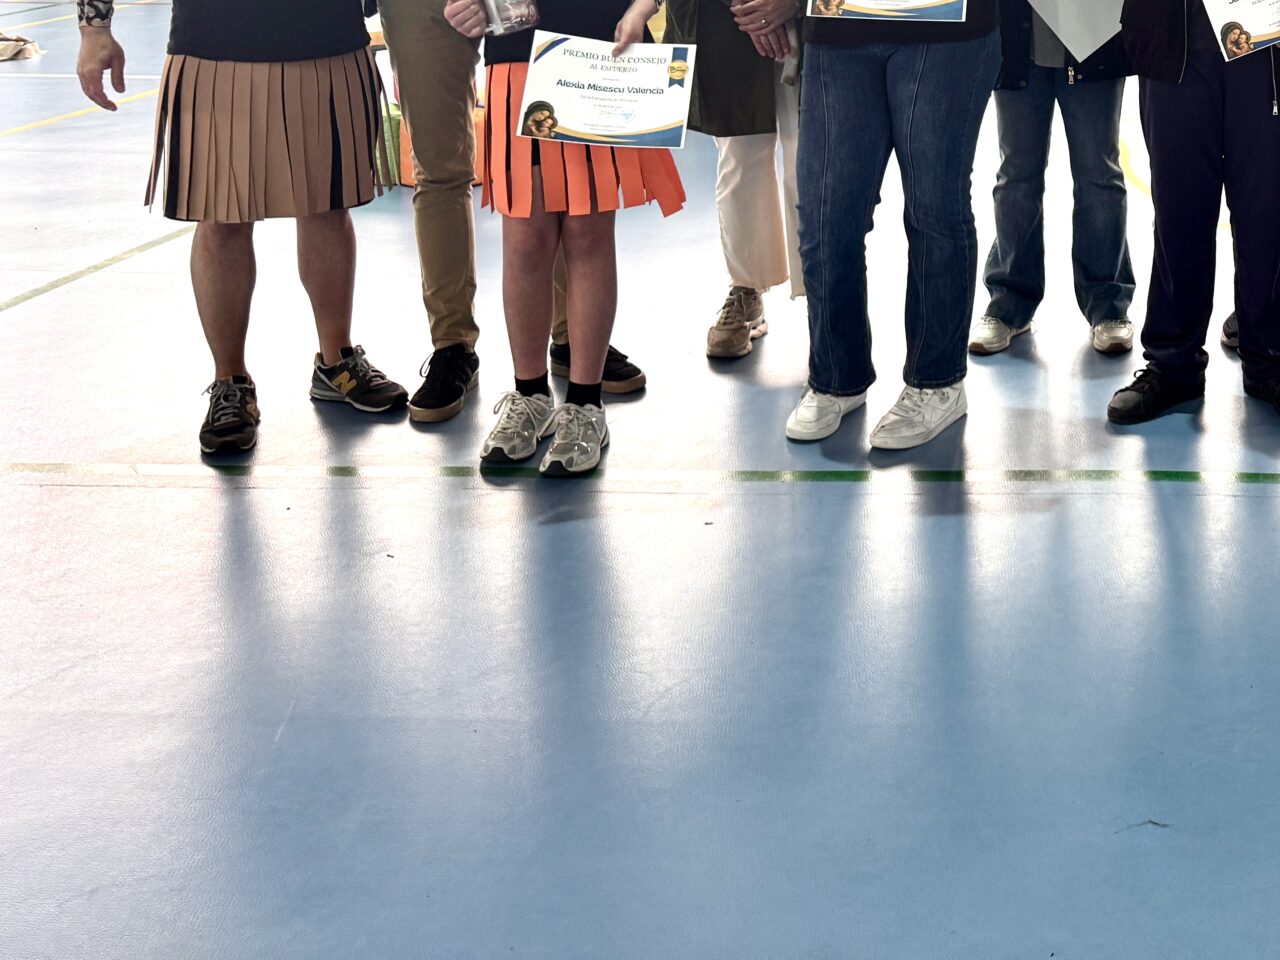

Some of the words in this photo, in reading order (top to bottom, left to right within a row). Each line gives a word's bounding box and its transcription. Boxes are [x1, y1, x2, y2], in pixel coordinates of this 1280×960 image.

[563, 48, 599, 60] PREMIO
[601, 55, 626, 63] BUEN
[556, 79, 584, 90] Alexia
[588, 83, 625, 94] Misescu
